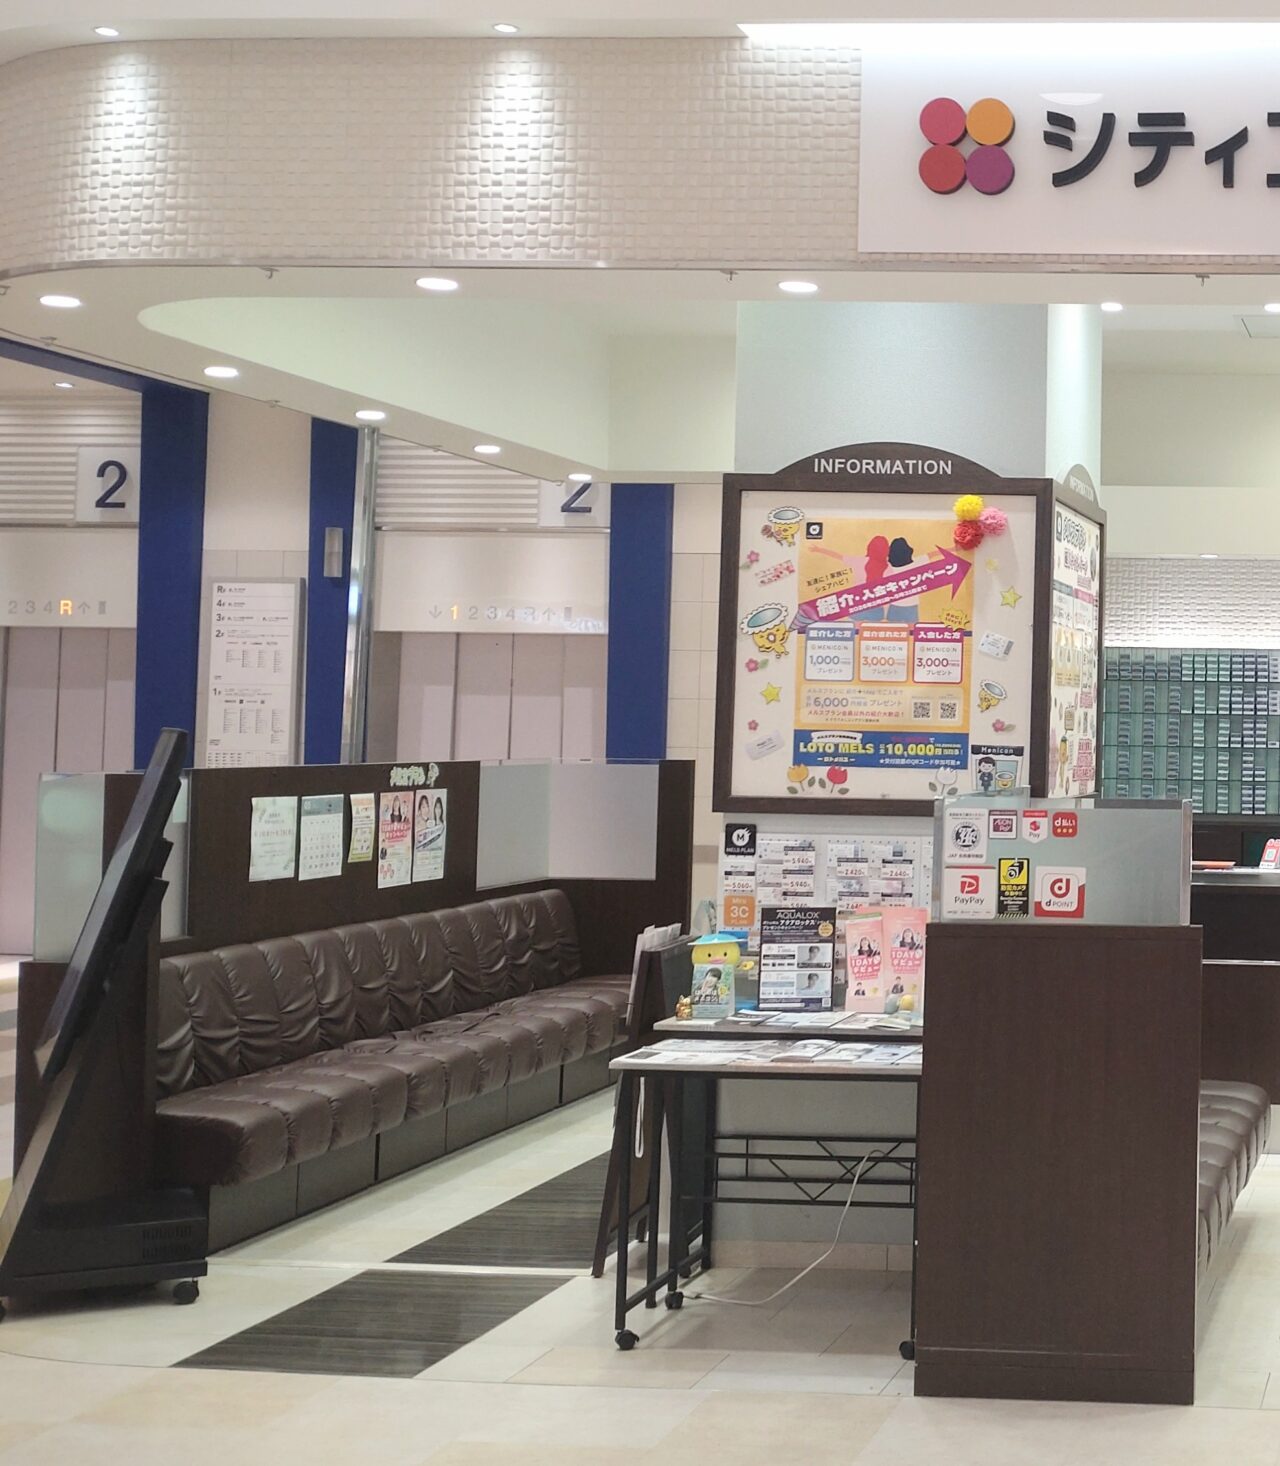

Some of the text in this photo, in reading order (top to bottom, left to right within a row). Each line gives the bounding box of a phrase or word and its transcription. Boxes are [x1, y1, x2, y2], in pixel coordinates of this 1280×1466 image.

[814, 458, 952, 475] INFORMATION
[95, 460, 127, 509] 2
[815, 563, 958, 617] 紹介・入会キャンペーン
[60, 599, 72, 616] R
[450, 604, 459, 620] 1
[916, 658, 949, 669] 3,000
[799, 741, 875, 754] LOTO MELS
[1054, 817, 1076, 827] d払い
[736, 833, 745, 841] M
[954, 896, 985, 906] PayPay
[730, 905, 750, 918] 3C
[776, 911, 819, 919] AQUALOX
[851, 957, 873, 967] 1DAY
